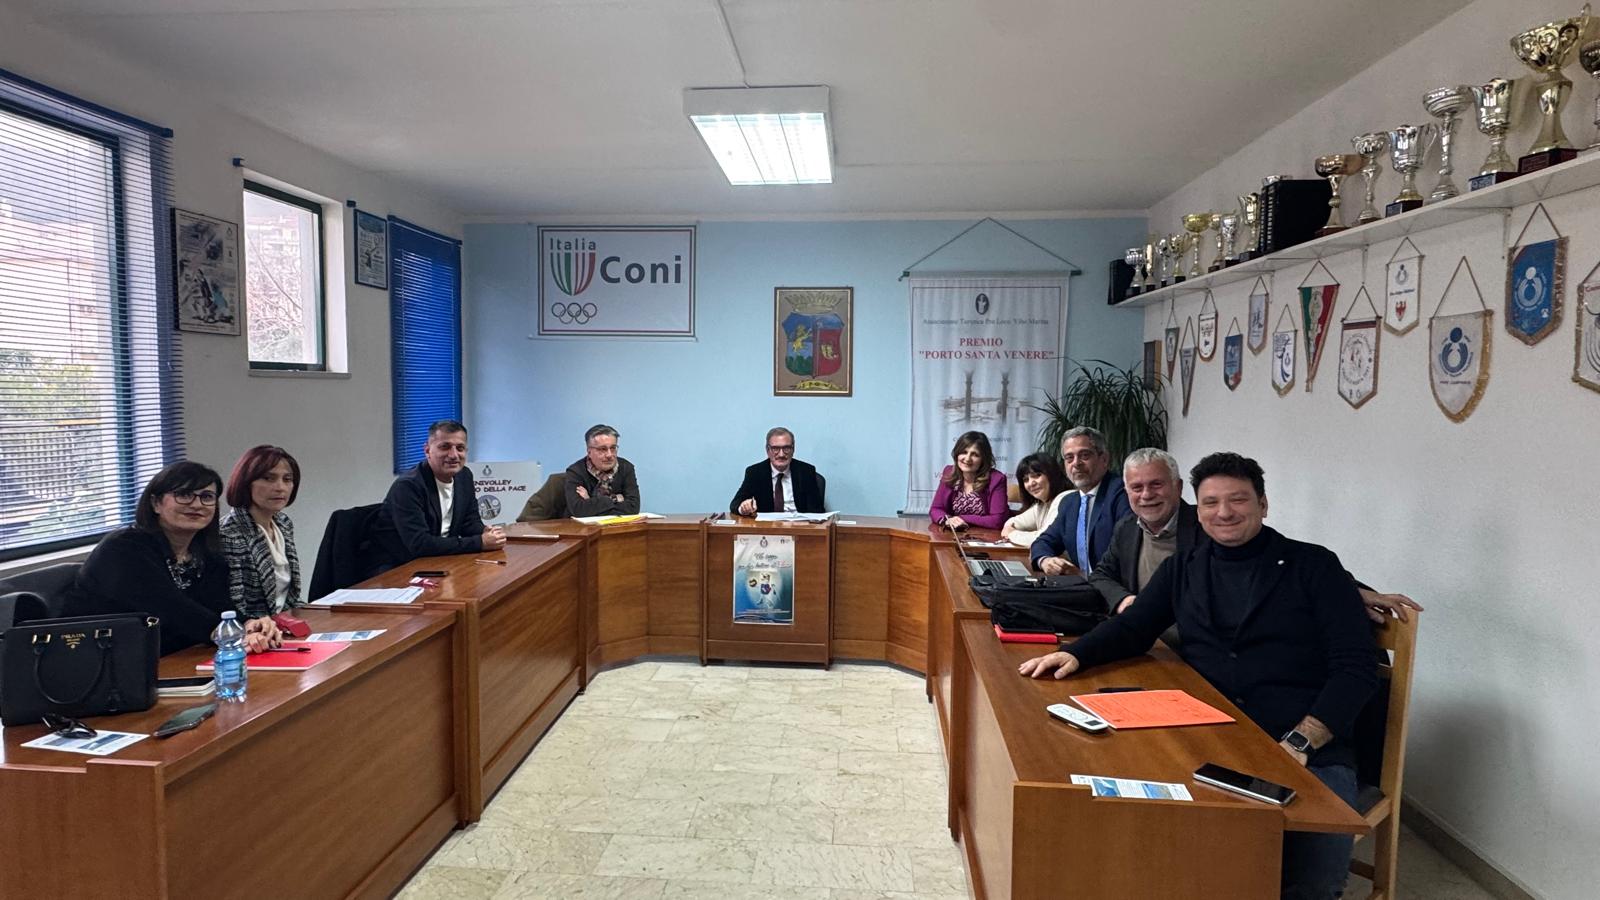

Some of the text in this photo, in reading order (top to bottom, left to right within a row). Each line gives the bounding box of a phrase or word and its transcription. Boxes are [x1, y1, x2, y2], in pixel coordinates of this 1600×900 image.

[550, 238, 596, 251] Italia
[600, 255, 682, 284] Coni
[959, 337, 1003, 347] PREMIO
[919, 350, 1054, 360] "PORTO SANTA VENERE"
